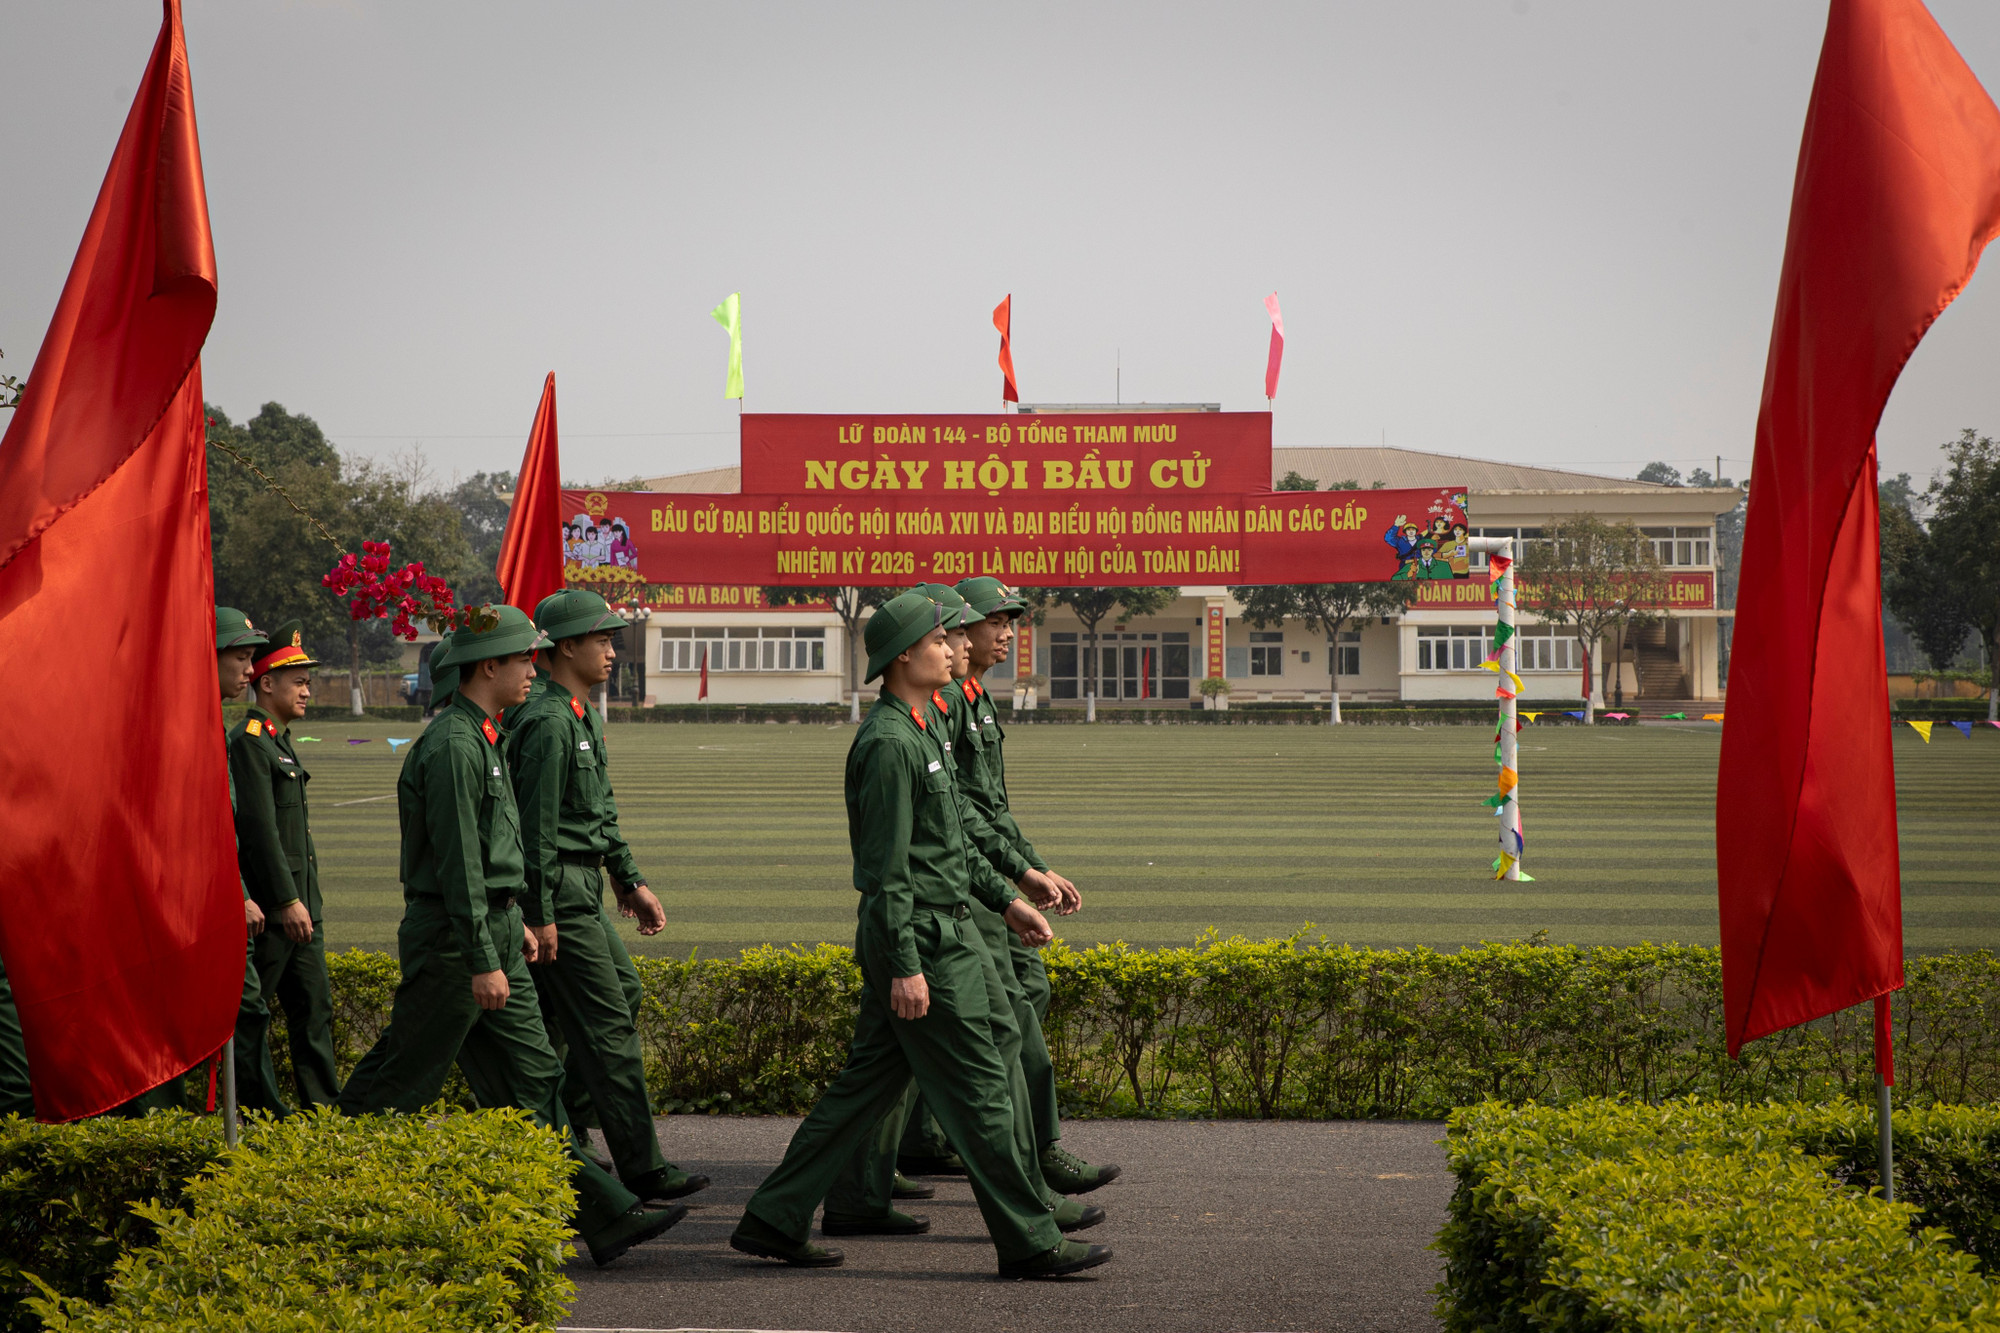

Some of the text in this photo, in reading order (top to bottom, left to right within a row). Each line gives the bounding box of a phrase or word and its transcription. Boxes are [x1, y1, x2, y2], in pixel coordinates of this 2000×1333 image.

[839, 423, 864, 444] LỮ
[873, 422, 926, 444] ĐOÀN
[932, 426, 967, 444] 144
[985, 422, 1012, 448] BỘ
[1016, 419, 1068, 444] TỔNG
[1072, 425, 1127, 444] THAM
[1133, 424, 1177, 444] MƯU
[804, 448, 1212, 497] NGÀY HỘI BẦU CỬ
[651, 498, 1368, 540] BẦU CỬ ĐẠI BIỂU QUỐC HỘI KHÓA XVI VÀ ĐẠI BIỂU HỘI ĐỒNG NHÂN DÂN CÁC CẤP
[777, 545, 837, 579] NHIỆM
[842, 546, 866, 574] KỲ
[870, 551, 915, 575] 2026
[932, 551, 974, 574] 2031
[982, 546, 1005, 574] LÀ
[1009, 546, 1059, 574] NGÀY
[1064, 545, 1095, 579] HỘI
[1100, 543, 1137, 574] CỦA
[1141, 545, 1190, 574] TOÀN
[1195, 544, 1240, 573] DÂN!
[687, 584, 707, 605] VÀ
[1455, 582, 1485, 603] ĐƠN
[1668, 580, 1705, 605] LỆNH
